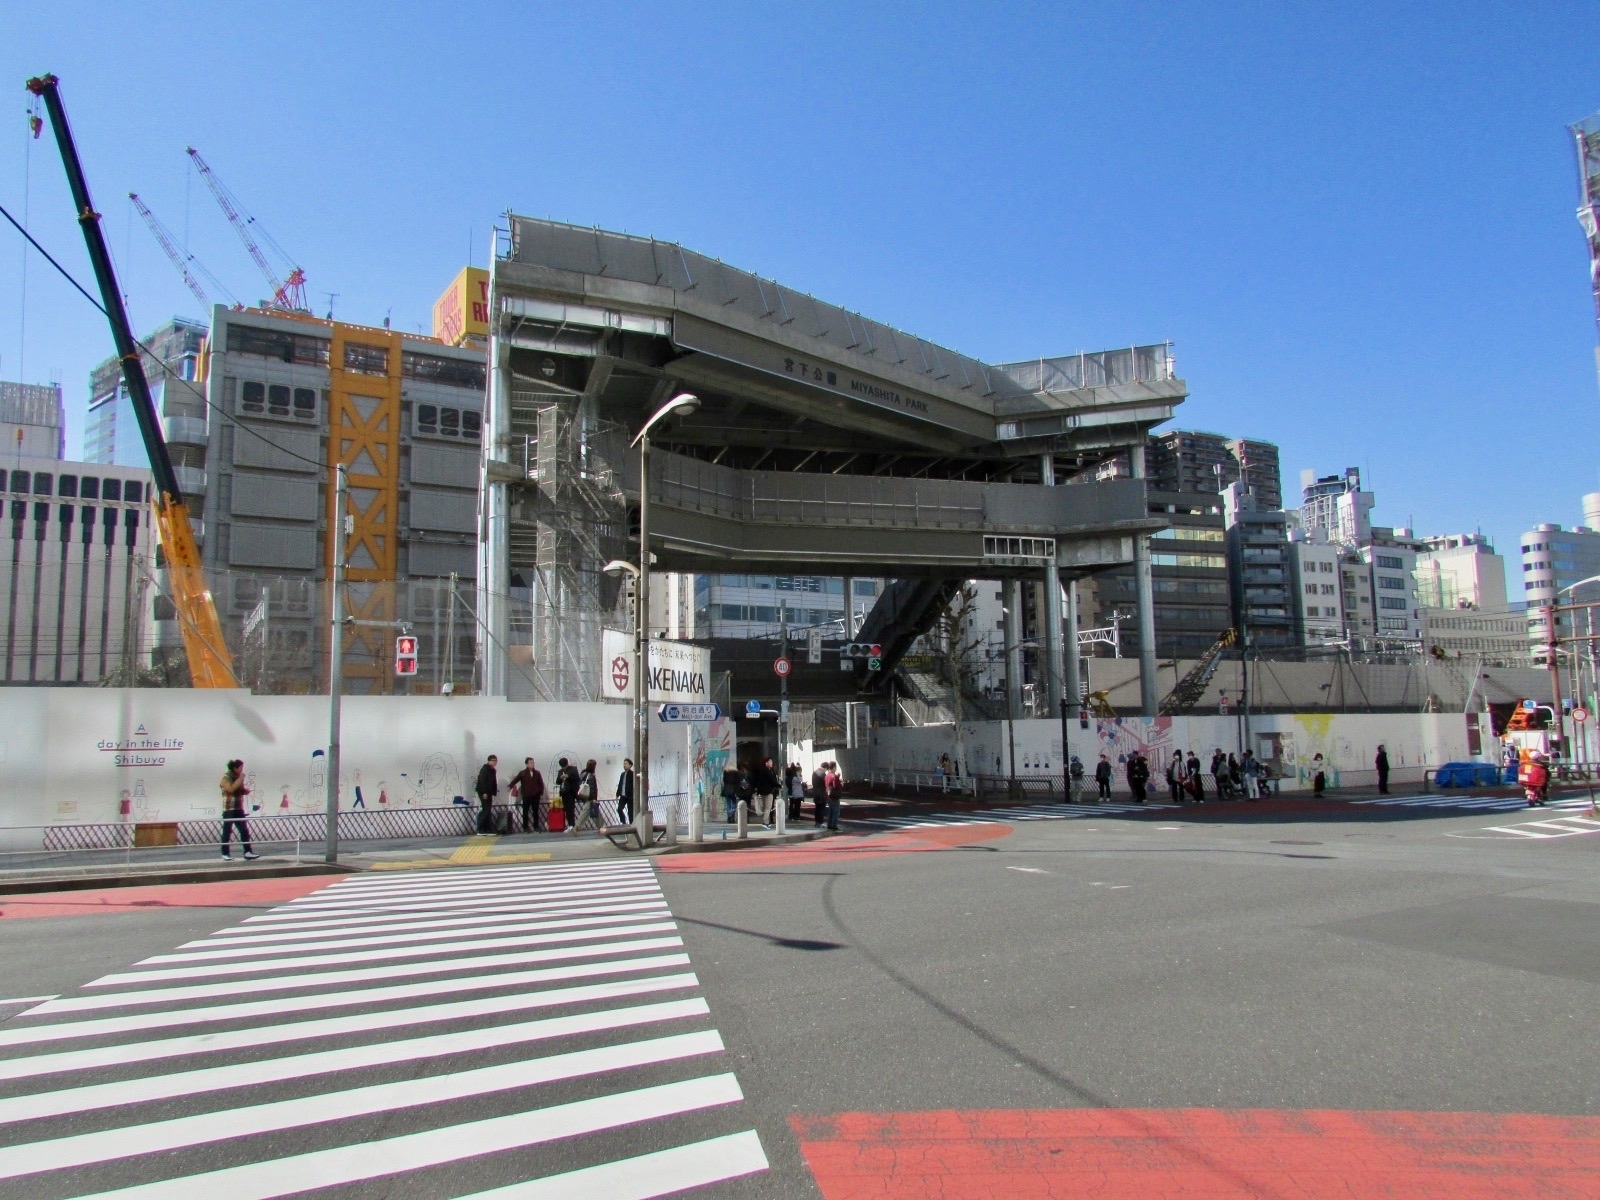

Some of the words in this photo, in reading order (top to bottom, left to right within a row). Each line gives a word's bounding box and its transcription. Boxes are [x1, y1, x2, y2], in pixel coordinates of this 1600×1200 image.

[851, 379, 901, 405] MIYASHITA
[905, 397, 929, 413] PARK
[779, 662, 788, 671] 40
[648, 666, 705, 695] AKENAKA
[682, 705, 713, 714] 明治通り
[137, 723, 146, 732] A
[97, 739, 121, 750] day
[126, 739, 137, 748] in
[141, 739, 160, 748] the
[164, 738, 184, 748] life
[114, 754, 165, 765] Shibuya
